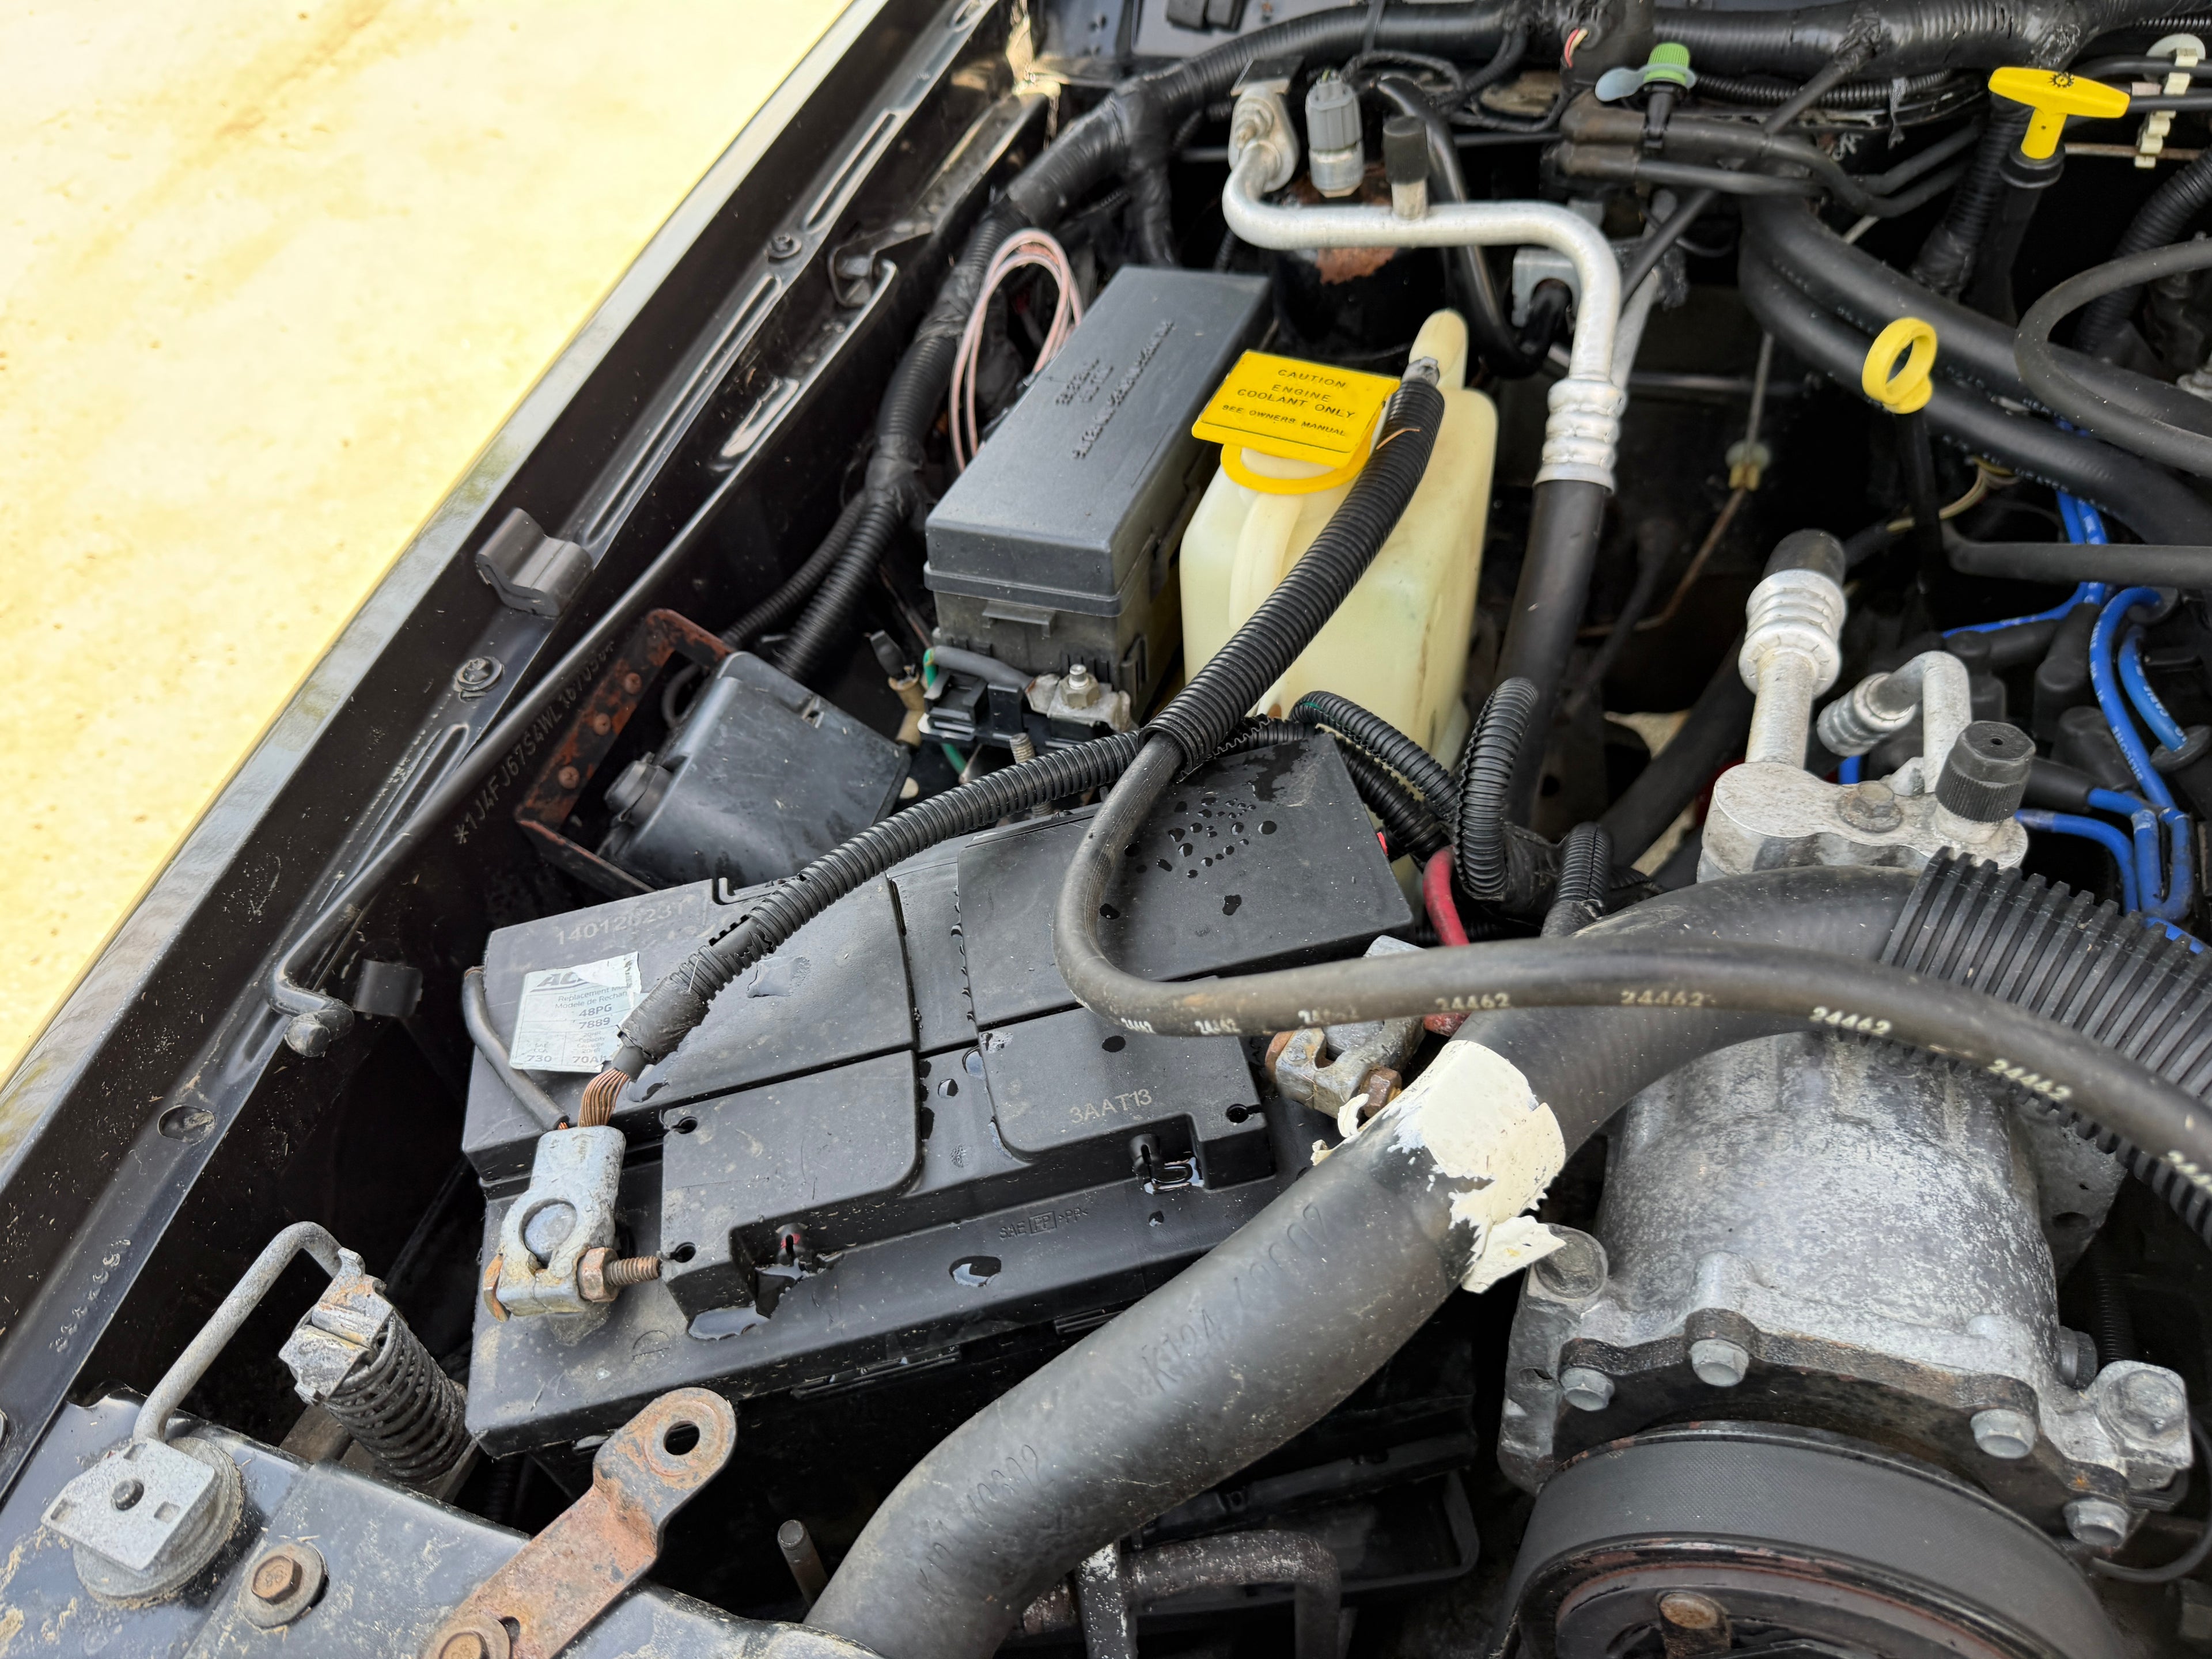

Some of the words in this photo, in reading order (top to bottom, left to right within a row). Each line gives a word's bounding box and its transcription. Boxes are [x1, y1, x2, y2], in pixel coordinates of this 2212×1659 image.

[1278, 369, 1347, 388] CAUTION
[1271, 384, 1332, 402] ENGINE
[1237, 388, 1308, 408] COOLANT
[1315, 404, 1355, 419] ONLY
[1222, 404, 1243, 414] SEE
[1249, 409, 1296, 424] OWNERS
[1301, 421, 1347, 437] MANUAL
[558, 987, 609, 1002] Replacement
[1435, 991, 1511, 1012] 24462
[1620, 989, 1705, 1007] 24462
[578, 1003, 612, 1017] 48PG
[578, 1017, 611, 1029] 7889
[527, 1055, 552, 1063] 730
[999, 1221, 1027, 1241] SAE
